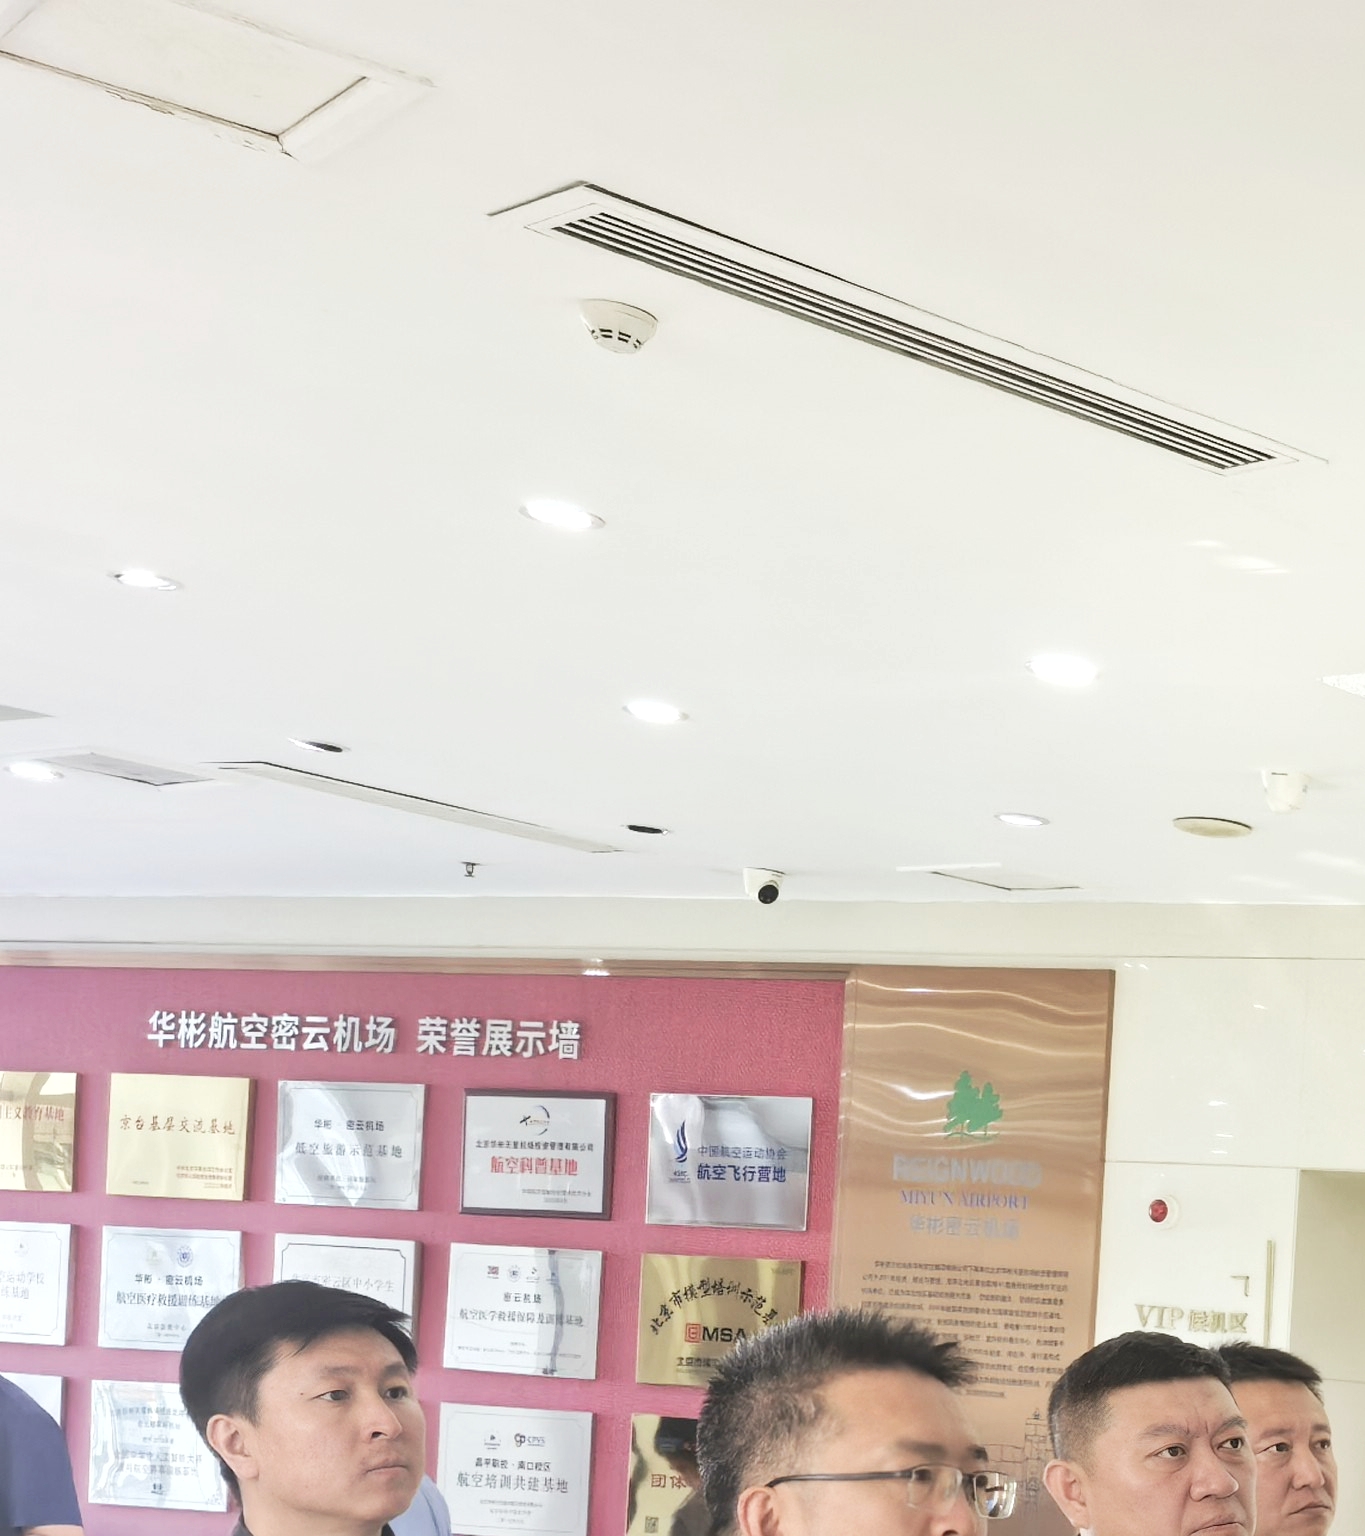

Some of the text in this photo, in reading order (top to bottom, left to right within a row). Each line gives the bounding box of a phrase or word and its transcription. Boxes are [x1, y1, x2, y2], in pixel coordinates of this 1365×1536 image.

[147, 1009, 580, 1060] 华彬航空密云机场 荣誉展示墙
[120, 1114, 236, 1135] 京台基层交流基地
[698, 1145, 788, 1161] 中国航空运动协会
[490, 1155, 578, 1177] 航空科普基地
[697, 1164, 787, 1184] 航空飞行营地
[893, 1153, 1043, 1188] REIGNWOOD
[900, 1189, 1031, 1210] MIYUN AIRPORT
[503, 1292, 543, 1304] 密云机场
[1134, 1303, 1185, 1331] VIP
